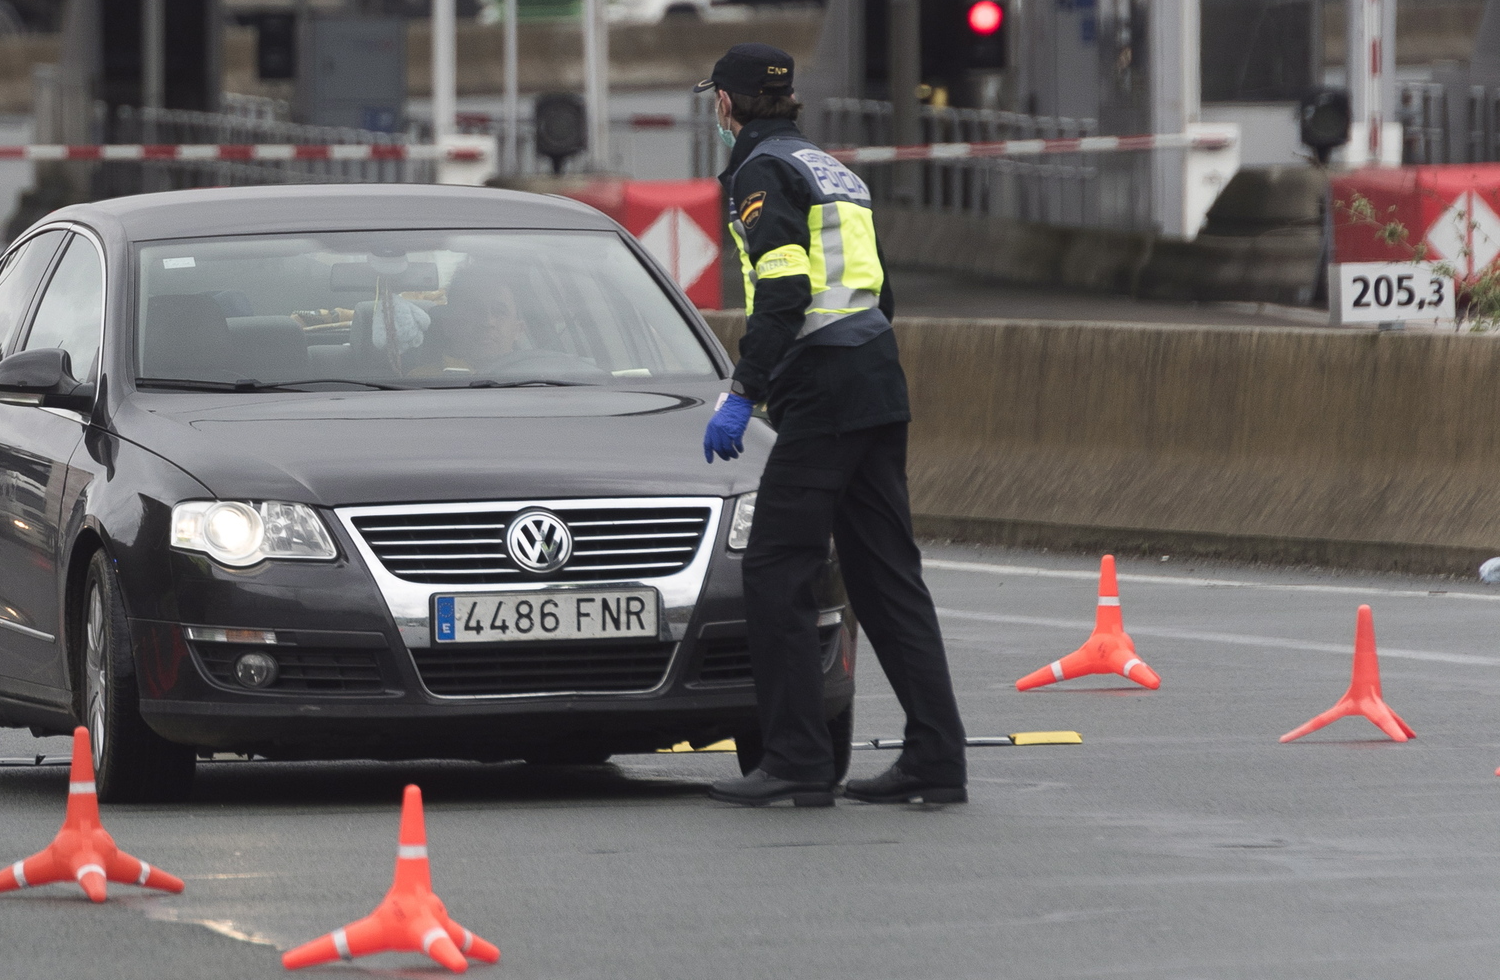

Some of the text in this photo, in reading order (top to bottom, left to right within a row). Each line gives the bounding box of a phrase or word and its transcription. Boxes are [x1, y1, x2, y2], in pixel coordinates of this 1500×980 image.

[767, 66, 788, 74] CNP
[1352, 273, 1445, 312] 205,3
[463, 596, 646, 635] 4486 FNR
[442, 623, 451, 634] E
